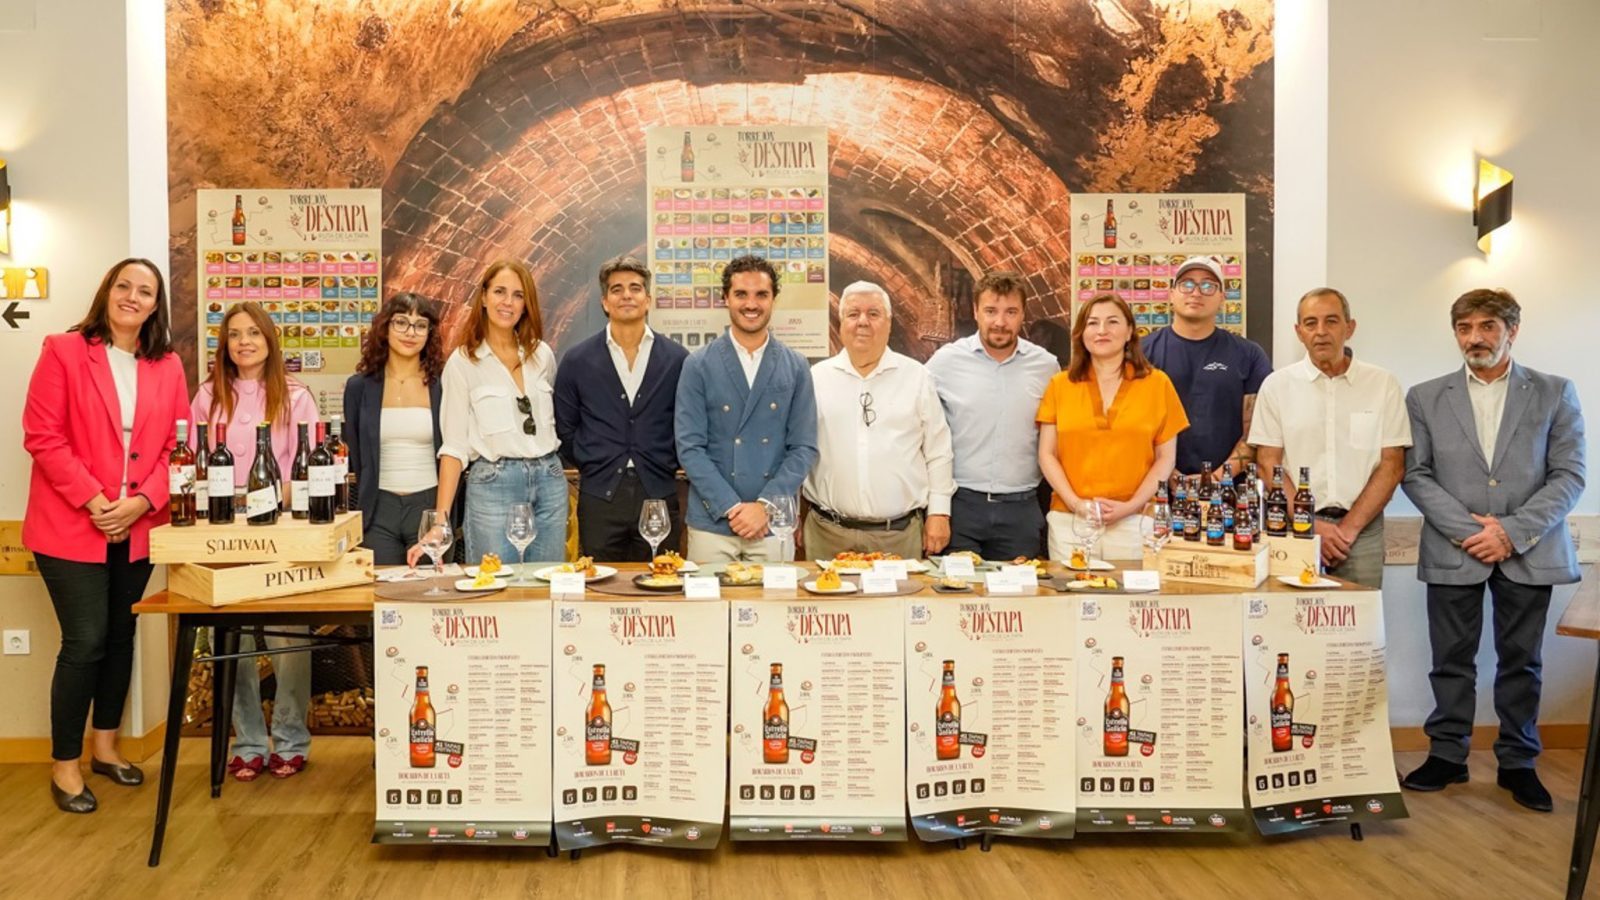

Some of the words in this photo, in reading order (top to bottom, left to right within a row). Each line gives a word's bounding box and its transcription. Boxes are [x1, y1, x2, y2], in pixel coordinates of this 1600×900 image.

[754, 142, 815, 168] DESTAPA
[306, 205, 369, 232] DESTAPA
[1174, 209, 1232, 235] DESTAPA
[206, 539, 278, 555] VIVALTUS
[265, 566, 325, 587] PINTIA
[624, 616, 675, 637] DESTAPA
[800, 614, 851, 636] DESTAPA
[972, 611, 1023, 633] DESTAPA
[1142, 608, 1191, 630] DESTAPA
[1308, 605, 1356, 626] DESTAPA
[446, 616, 498, 638] DESTAPA
